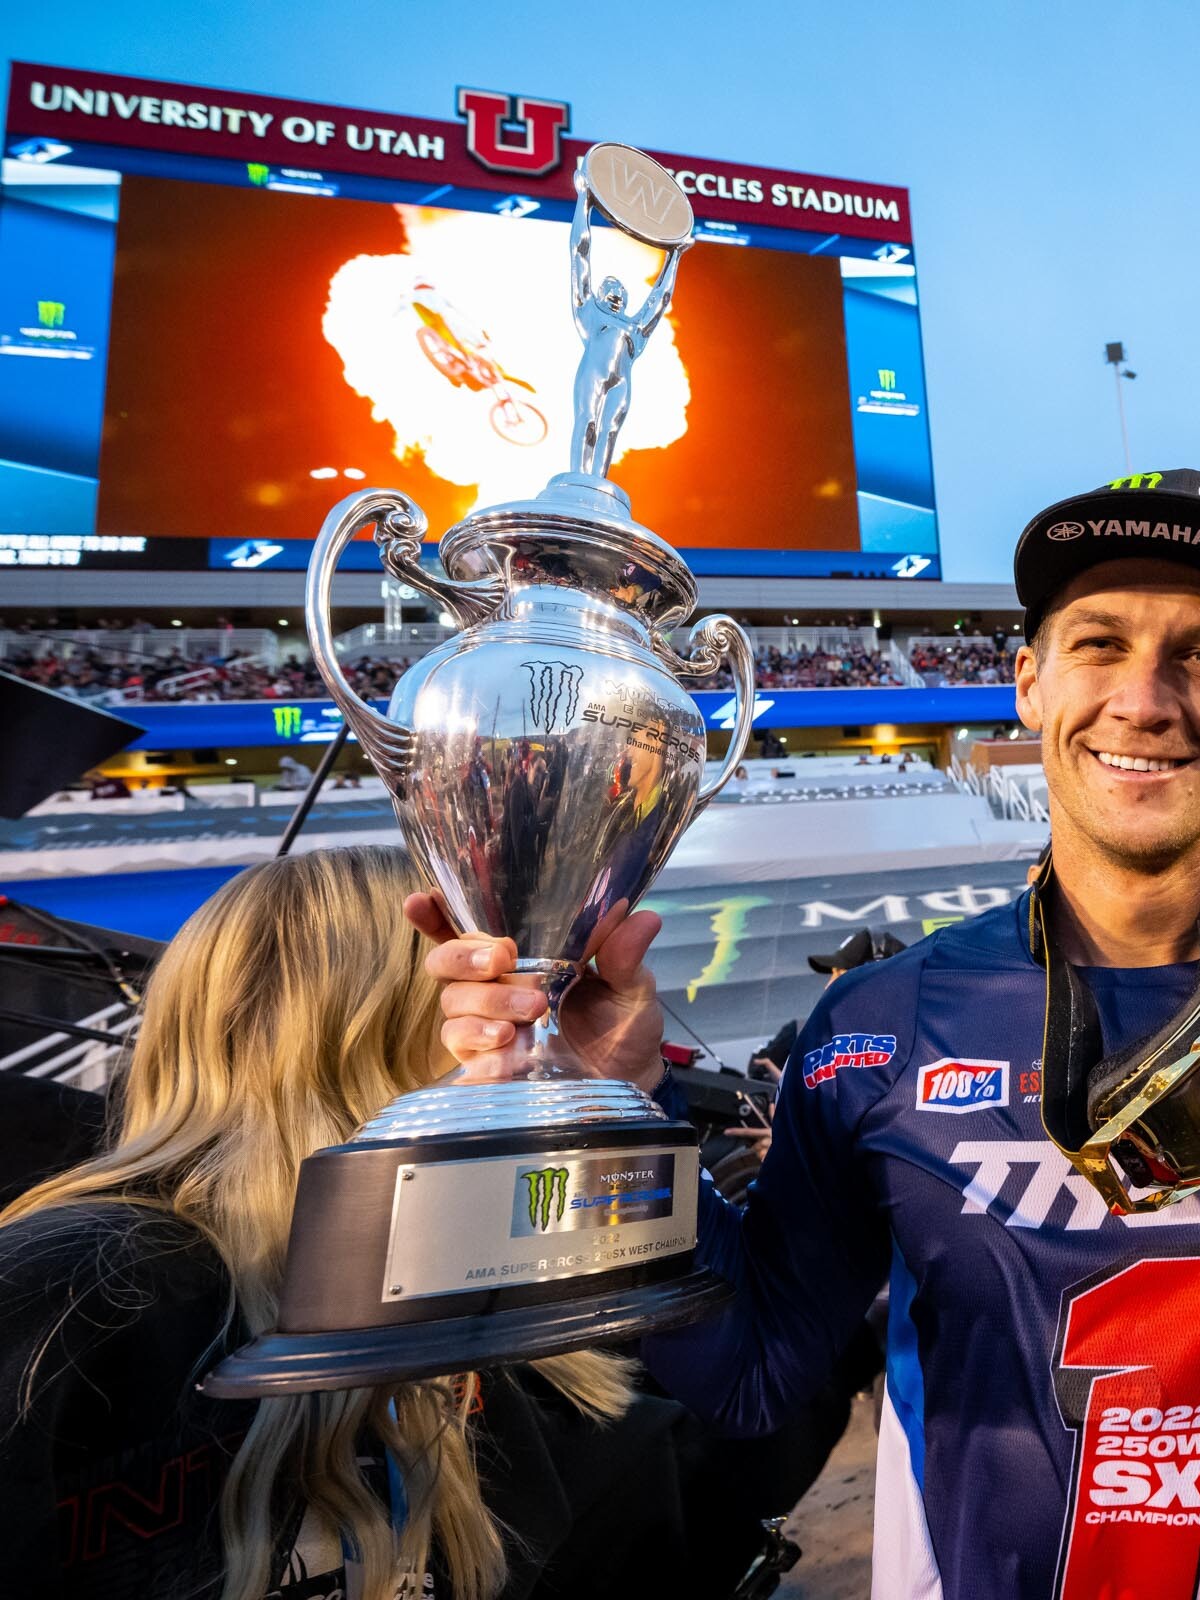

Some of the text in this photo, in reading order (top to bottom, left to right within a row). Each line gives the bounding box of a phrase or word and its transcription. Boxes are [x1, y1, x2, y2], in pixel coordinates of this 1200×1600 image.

[30, 82, 445, 161] UNIVERSITY OF UTAH
[666, 168, 900, 222] CCLES STADIUM
[587, 703, 606, 712] AMA
[580, 709, 701, 763] SUPERCROSS
[802, 1033, 896, 1076] PARTS
[928, 1069, 996, 1101] 100%
[600, 1170, 655, 1182] MONSTER
[465, 1267, 496, 1281] AMA
[628, 1242, 654, 1257] WEST
